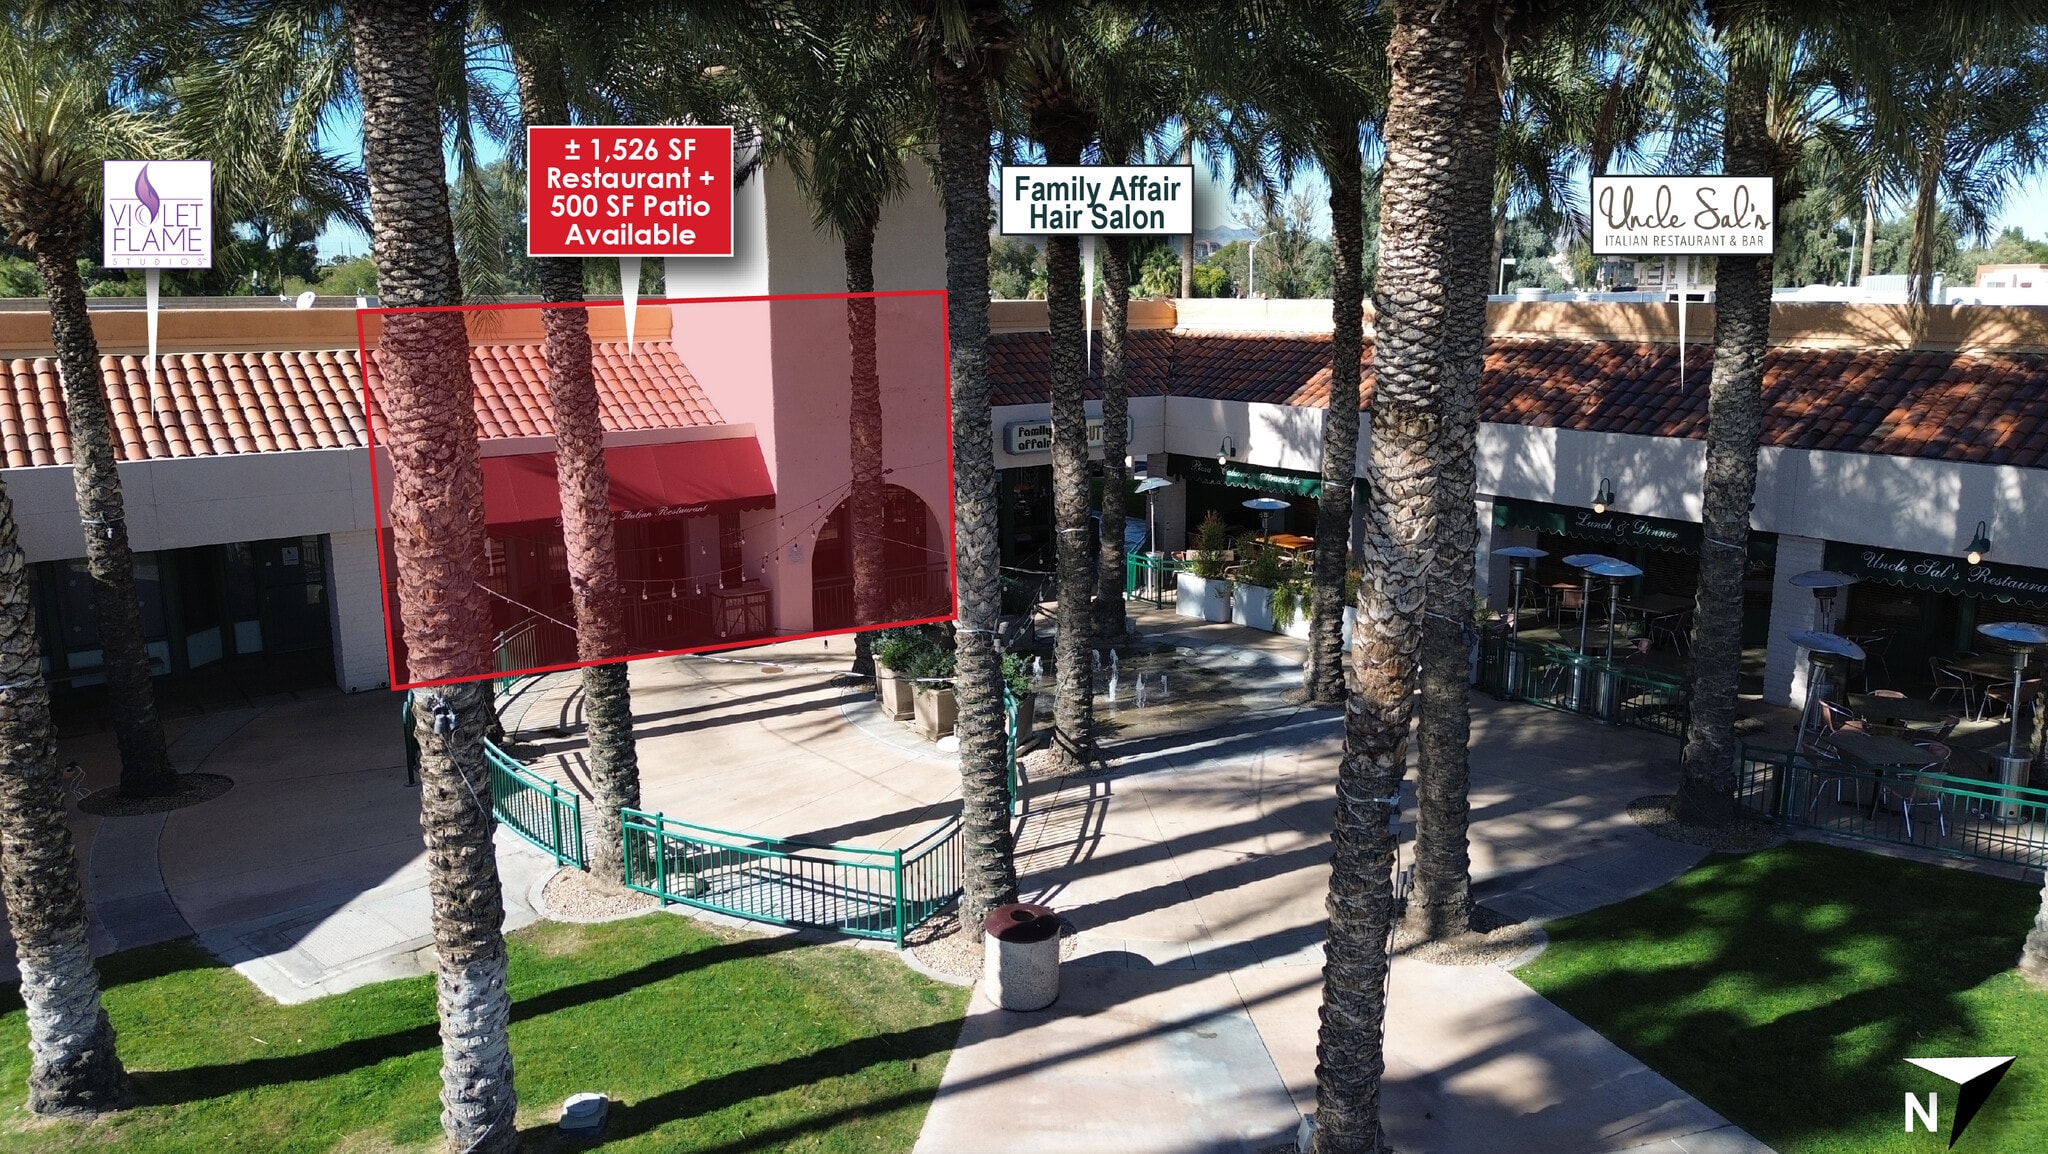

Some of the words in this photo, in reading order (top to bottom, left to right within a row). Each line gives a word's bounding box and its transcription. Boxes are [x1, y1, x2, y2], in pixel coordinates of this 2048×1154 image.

[619, 508, 652, 522] Italian
[655, 503, 709, 518] Restaurant
[1575, 511, 1614, 531] Lunch
[1614, 520, 1630, 537] &
[1632, 519, 1680, 539] Dinner
[1861, 551, 1908, 573] Uncle
[1913, 558, 1960, 581] Sal's
